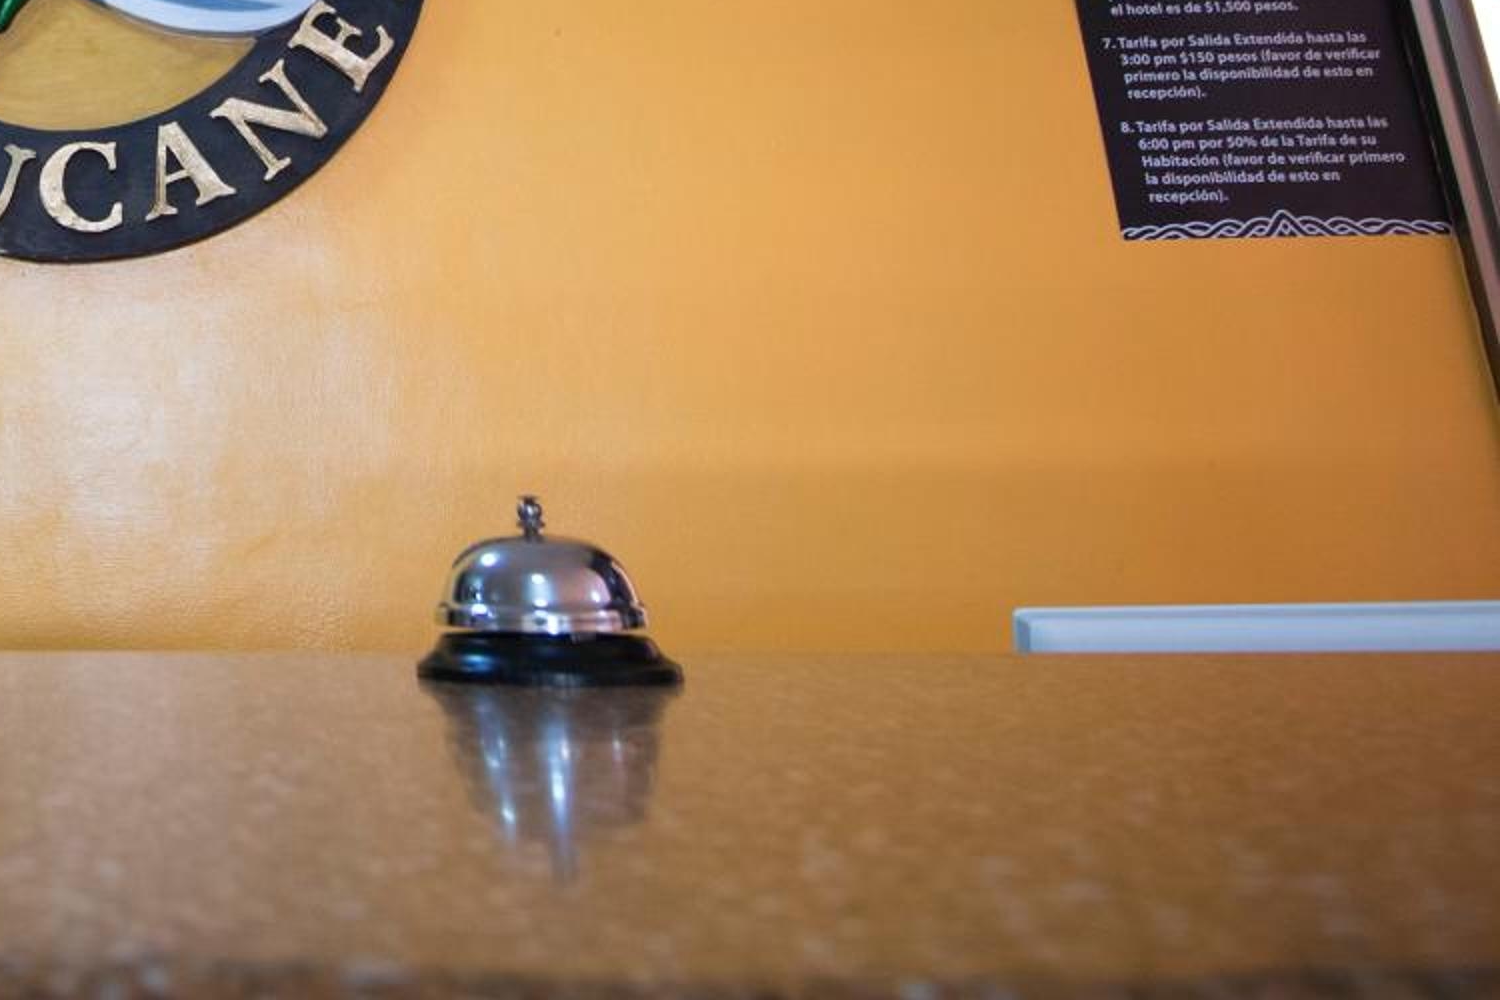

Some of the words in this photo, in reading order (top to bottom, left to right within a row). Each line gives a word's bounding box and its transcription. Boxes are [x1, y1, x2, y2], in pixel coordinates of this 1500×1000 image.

[1110, 3, 1124, 15] el
[1125, 2, 1164, 15] hotel
[1165, 4, 1182, 14] es
[1183, 1, 1203, 13] de
[1203, 0, 1252, 14] $1,500
[1253, 1, 1299, 15] pesos.
[1102, 37, 1117, 49] 7.
[1116, 35, 1159, 49] Tarifa
[1160, 37, 1185, 51] por
[1187, 33, 1232, 47] Salida
[1233, 31, 1304, 46] Extendida
[1305, 31, 1345, 44] hasta
[1345, 30, 1367, 43] las
[1153, 54, 1177, 68] pm
[1179, 51, 1216, 65] $150
[1217, 52, 1259, 65] pesos
[1303, 48, 1323, 61] de
[1323, 47, 1381, 60] verificar
[1127, 85, 1207, 101] recepción).
[1137, 137, 1170, 149] 6:00
[1171, 139, 1196, 152] pm
[1197, 138, 1224, 152] por
[1225, 135, 1258, 147] 50%
[1259, 135, 1279, 147] de
[1280, 134, 1295, 146] la
[1295, 133, 1337, 146] Tarifa
[1338, 133, 1358, 145] de
[1360, 135, 1377, 145] su
[1141, 153, 1220, 166] Habitación
[1221, 153, 1265, 168] (favor
[1266, 151, 1286, 164] de
[1287, 151, 1345, 164] verificar
[1347, 150, 1406, 166] primero
[1148, 188, 1229, 205] recepción).
